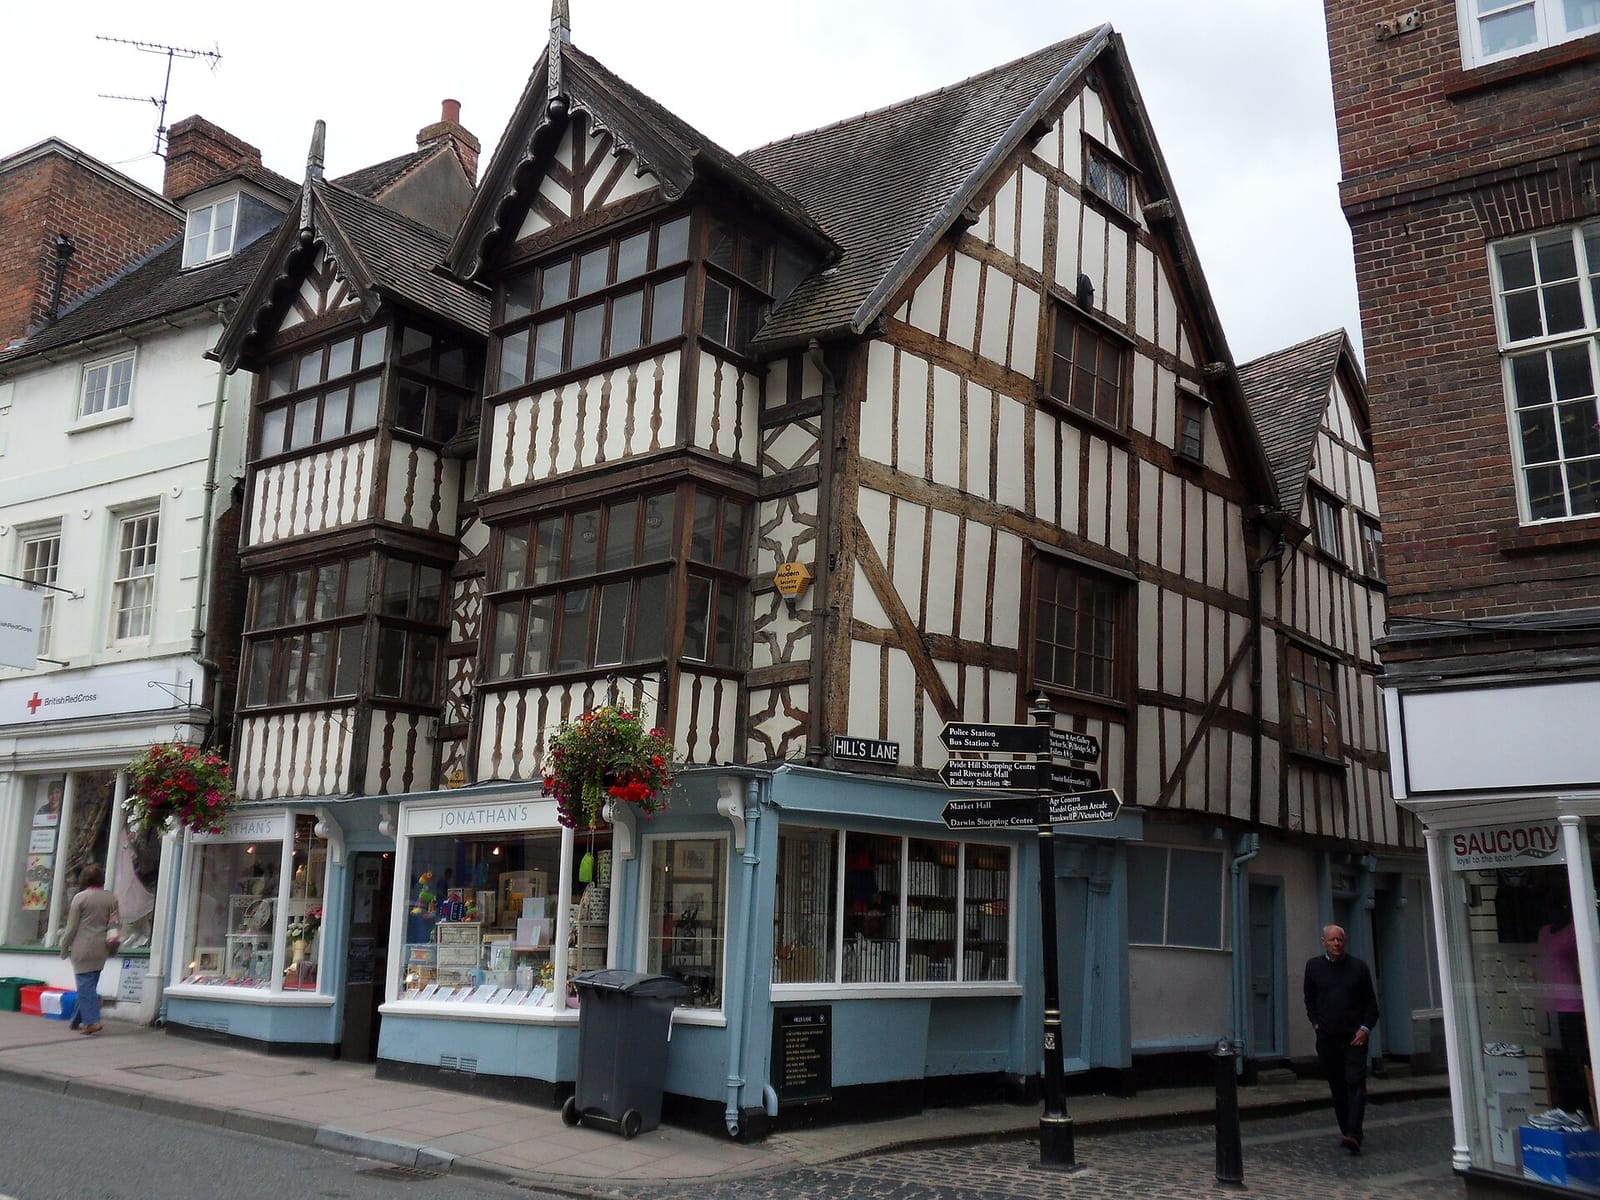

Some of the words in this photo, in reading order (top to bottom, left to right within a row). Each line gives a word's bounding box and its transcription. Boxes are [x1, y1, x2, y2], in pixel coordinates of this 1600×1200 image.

[949, 727, 969, 736] Police
[970, 728, 996, 737] Station
[949, 737, 962, 746] Bus
[964, 738, 990, 747] Station
[835, 739, 866, 757] HILL'S
[870, 743, 898, 760] LANE
[949, 760, 967, 769] Pride
[967, 761, 981, 769] Hill
[981, 762, 1013, 772] Shopping
[949, 769, 962, 777] and
[963, 769, 993, 778] Riverside
[993, 770, 1009, 778] Mall
[949, 778, 975, 788] Railway
[976, 778, 1001, 787] Station
[950, 802, 974, 810] Market
[976, 801, 992, 809] Hall
[1067, 803, 1089, 812] Gardens
[1089, 800, 1108, 810] Arcade
[439, 804, 528, 830] JONATHAN'S
[950, 818, 976, 827] Darwin
[976, 817, 1009, 828] Shopping
[1010, 816, 1034, 825] Centre
